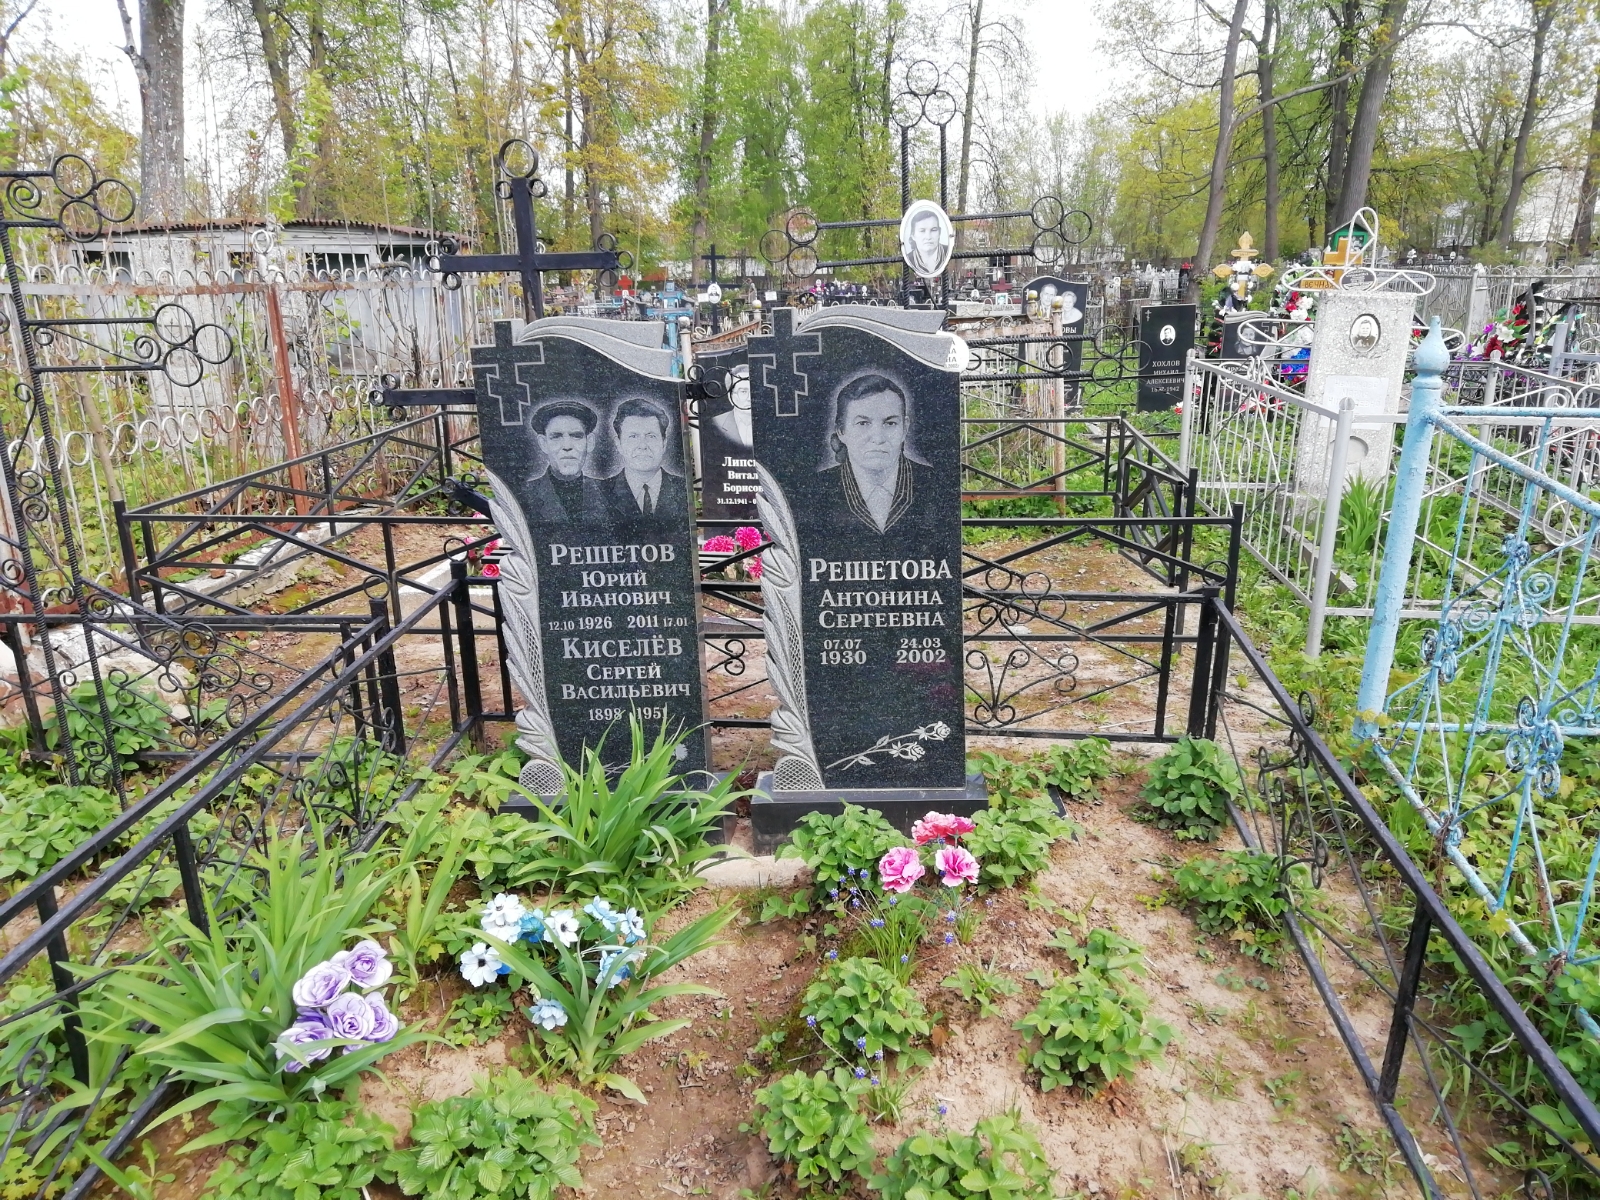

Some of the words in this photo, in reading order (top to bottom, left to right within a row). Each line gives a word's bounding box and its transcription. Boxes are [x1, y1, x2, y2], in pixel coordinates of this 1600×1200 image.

[1152, 360, 1180, 368] ХОХЛОВ
[549, 543, 675, 566] РЕШЕТОВ
[808, 558, 953, 582] РЕШЕТОВА
[581, 570, 648, 588] ЮРИЙ
[561, 591, 672, 608] ИВАНОВИЧ
[819, 589, 944, 607] АНТОНИНА
[548, 620, 575, 631] 12.10
[579, 616, 613, 630] 1926
[627, 615, 659, 629] 2011
[663, 617, 688, 628] 17.01
[818, 610, 945, 629] СЕРГЕЕВНА
[561, 634, 683, 658] КИСЕЛЁВ
[823, 639, 862, 650] 07.07
[900, 638, 941, 649] 24.03
[820, 651, 867, 665] 1930
[896, 650, 946, 664] 2002
[586, 663, 662, 680] СЕРГЕЙ
[561, 683, 691, 700] ВАСИЛЬЕВИЧ
[589, 707, 622, 721] 1898
